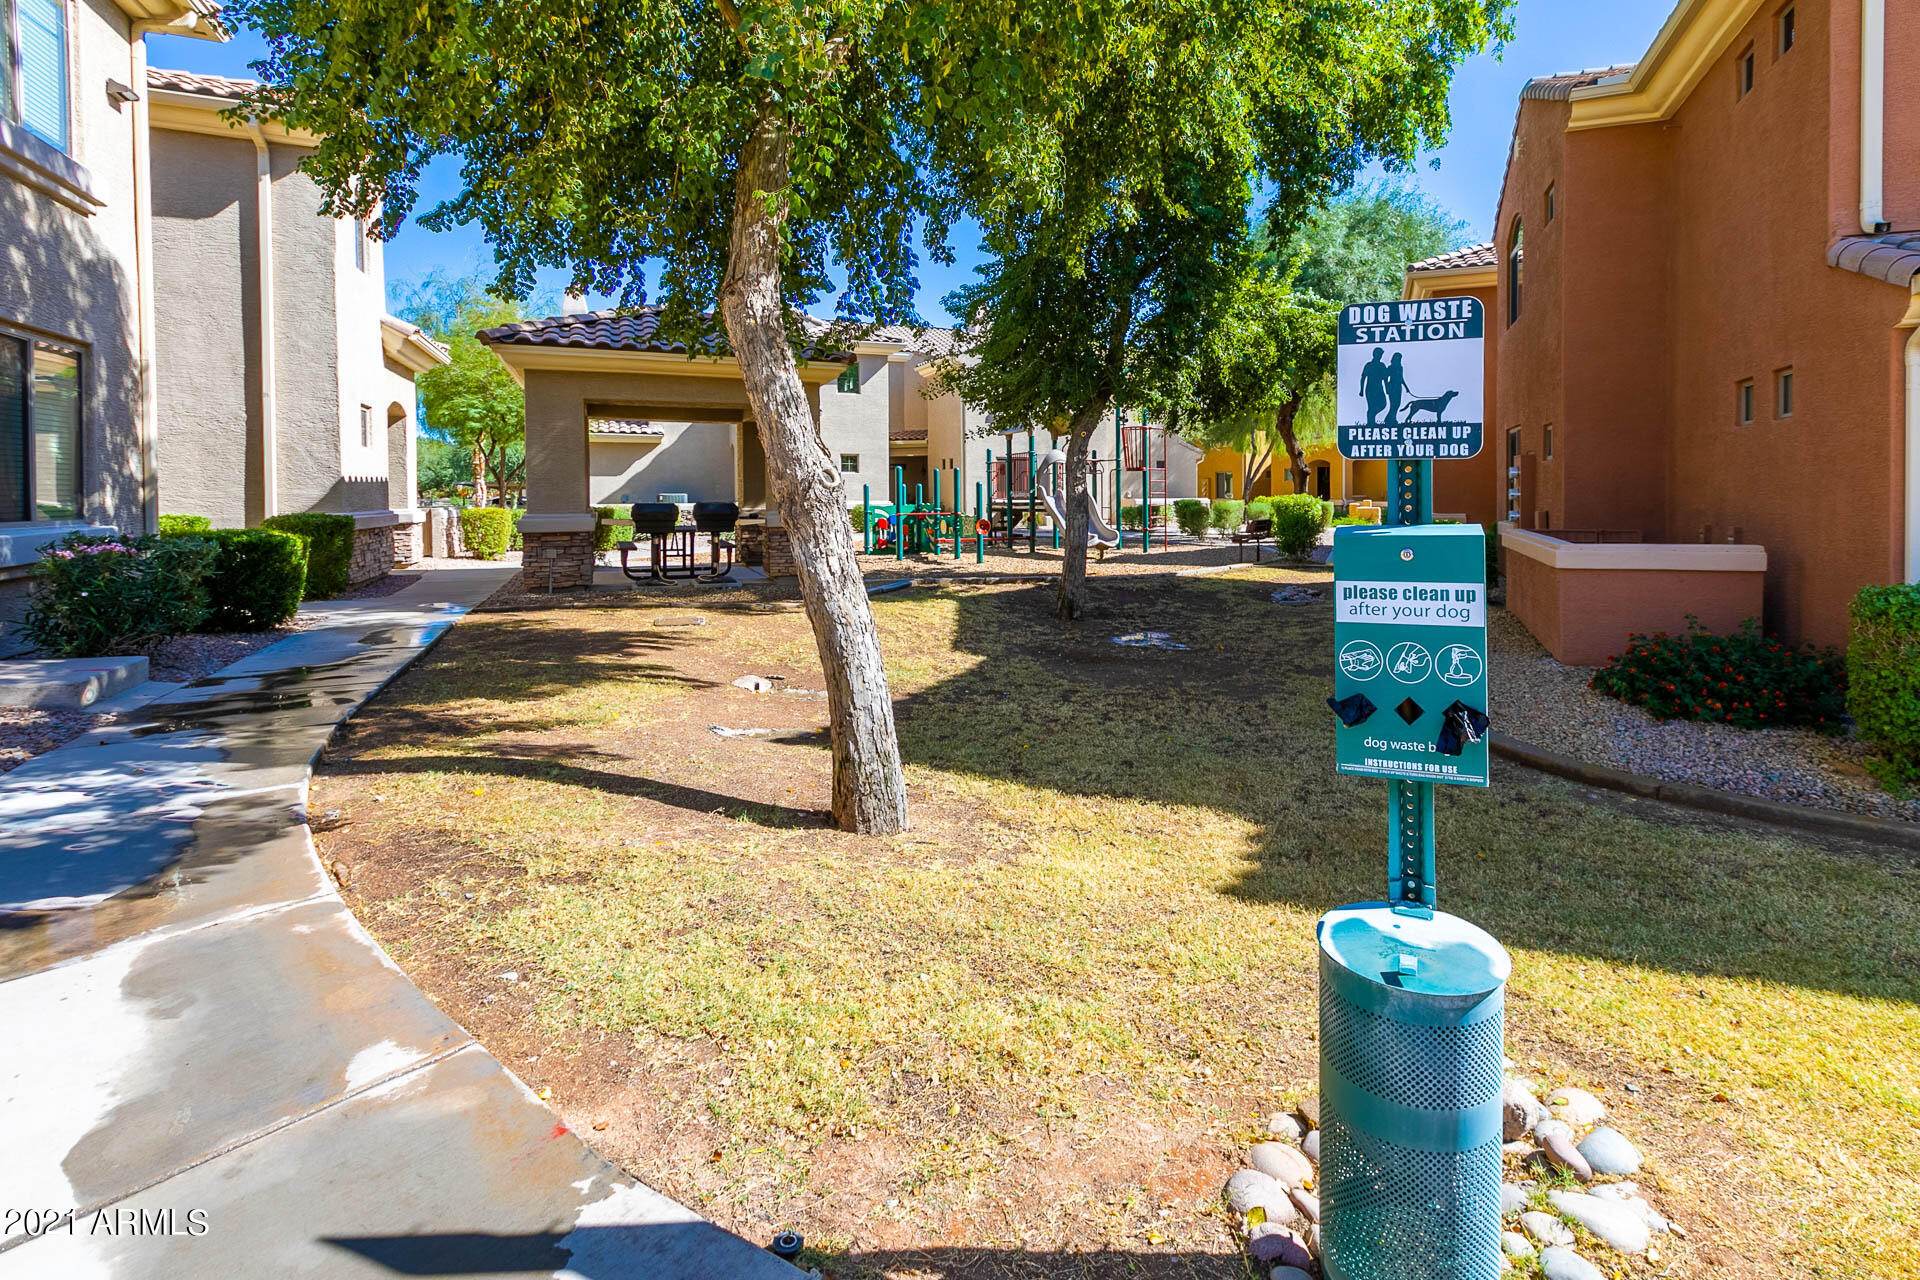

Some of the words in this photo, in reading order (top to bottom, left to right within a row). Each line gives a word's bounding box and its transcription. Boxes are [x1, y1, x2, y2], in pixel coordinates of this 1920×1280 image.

[1349, 305, 1390, 324] DOG
[1399, 300, 1472, 321] WASTE
[1355, 322, 1464, 343] STATION
[1349, 427, 1398, 441] PLEASE
[1402, 426, 1446, 440] CLEAN
[1452, 426, 1471, 439] UP
[1351, 444, 1392, 457] AFTER
[1397, 443, 1435, 457] YOUR
[1439, 443, 1469, 456] DOG
[1343, 585, 1398, 601] please
[1402, 586, 1450, 602] clean
[1455, 589, 1476, 604] up
[1349, 602, 1387, 616] after
[1392, 606, 1430, 620] your
[1436, 604, 1470, 622] dog
[1363, 736, 1387, 751] dog
[1390, 741, 1426, 752] waste
[1364, 758, 1423, 771] INSTRUCTIONS
[1424, 763, 1440, 773] FOR
[1441, 765, 1458, 774] USE
